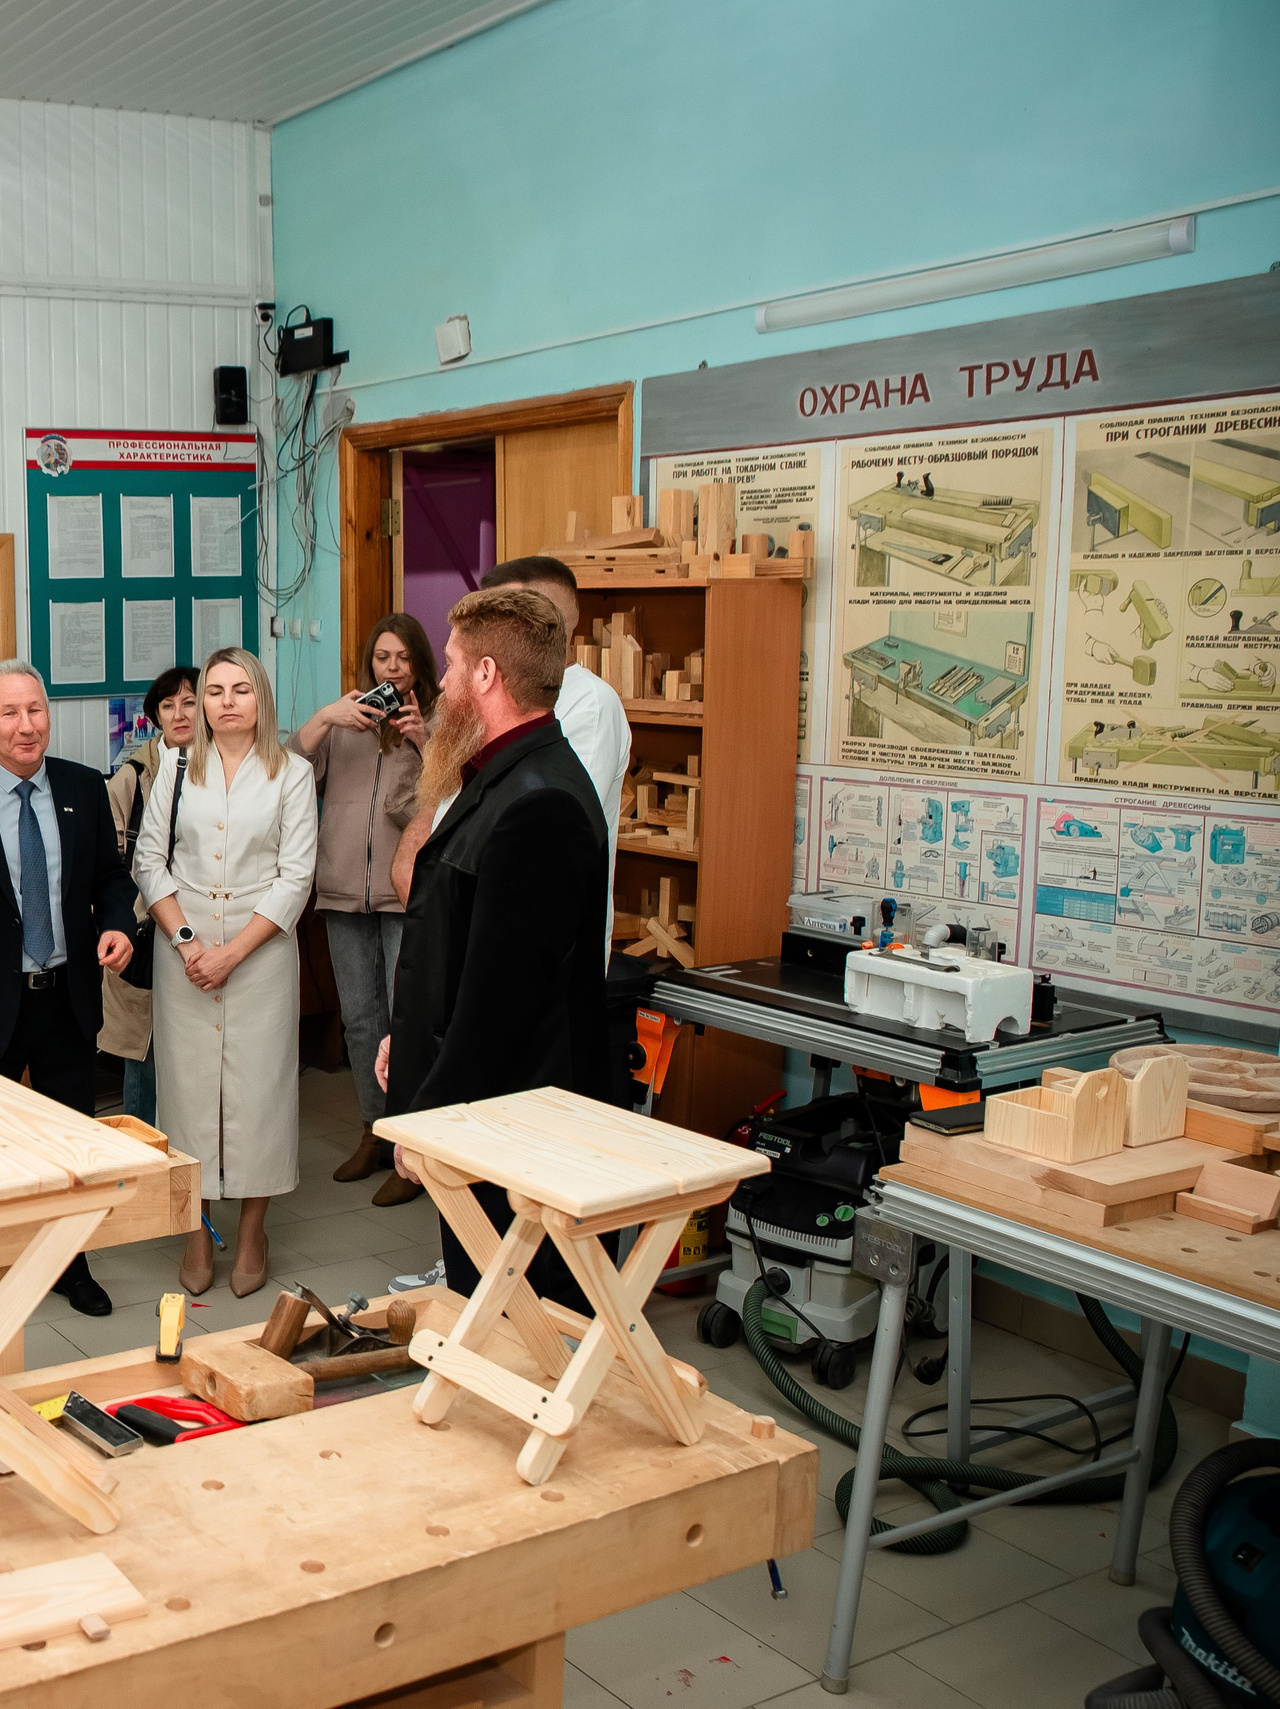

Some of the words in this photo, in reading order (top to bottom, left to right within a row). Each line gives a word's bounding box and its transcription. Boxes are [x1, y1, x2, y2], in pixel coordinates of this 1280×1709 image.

[799, 372, 931, 418] ОХРАНА
[958, 348, 1100, 398] ТРУДА
[1099, 418, 1145, 430] СОБЛЮДАЙ
[1147, 414, 1185, 425] ПРАВИЛА
[1189, 410, 1228, 421] ТЕХНИКИ
[1105, 430, 1129, 443] ПРИ
[1135, 422, 1207, 440] СТРОГАНИИ
[108, 440, 221, 451] ПРОФЕССИОНАЛЬНАЯ
[864, 444, 901, 453] СОБЛЮДАЙ
[903, 441, 933, 450] ПРАВИЛА
[938, 438, 968, 447] ТЕХНИКИ
[970, 433, 1027, 444] БЕЗОПАСНОСТИ
[119, 452, 213, 462] ХАРАКТЕРИСТИКА
[706, 458, 732, 466] ПРАВИЛА
[735, 455, 760, 463] ТЕХНИКИ
[762, 451, 806, 460] БЕЗОПАСНОСТИ
[851, 456, 894, 470] РАБОЧЕМУ
[991, 445, 1039, 460] ПОРЯДОК
[672, 470, 688, 479] ПРИ
[691, 466, 718, 477] РАБОТЕ
[721, 466, 732, 475] НА
[735, 462, 776, 473] ТОКАРНОМ
[780, 459, 808, 471] СТАНКЕ
[985, 543, 993, 553] 12
[1082, 552, 1119, 560] ПРАВИЛЬНО
[1128, 551, 1161, 559] НАДЕЖНО
[1163, 550, 1202, 558] ЗАКРЕПЛЯЙ
[1204, 549, 1244, 557] ЗАГОТОВКИ
[1185, 634, 1219, 642] РАБОТАЙ
[1185, 641, 1239, 649] НАЛАЖЕННЫМ
[1065, 689, 1115, 697] ПРИДЕРЖИВАЙ
[1080, 682, 1112, 690] НАЛАДКЕ
[1181, 702, 1223, 710] ПРАВИЛЬНО
[1226, 703, 1253, 711] ДЕРЖИ
[869, 742, 908, 750] ПРОИЗВОДИ
[841, 748, 870, 756] ПОРЯДОК
[878, 750, 906, 759] ЧИСТОТА
[908, 752, 917, 760] НА
[919, 754, 950, 763] РАБОЧЕМ
[953, 756, 975, 765] МЕСТЕ
[981, 760, 1012, 769] ВАЖНОЕ
[871, 757, 905, 766] КУЛЬТУРЫ
[907, 760, 928, 768] ТРУДА
[937, 763, 988, 774] БЕЗОПАСНОСТИ
[991, 768, 1021, 777] РАБОТЫ
[879, 775, 915, 784] ДОЛБЛЕНИЕ
[922, 778, 958, 787] СВЕРЛЕНИЕ
[1074, 776, 1119, 786] ПРАВИЛЬНО
[1122, 780, 1149, 789] КЛАДИ
[1152, 783, 1215, 794] ИНСТРУМЕНТЫ
[1218, 788, 1230, 796] НА
[1234, 789, 1279, 800] ВЕРСТАКЕ
[1114, 797, 1157, 807] СТРОГАНИЕ
[1162, 801, 1212, 811] ДРЕВЕСИНЫ
[805, 918, 836, 930] Аптечка
[758, 1132, 792, 1147] FESTOOL
[861, 1232, 905, 1255] FESTOOL
[1180, 1625, 1257, 1696] makita
